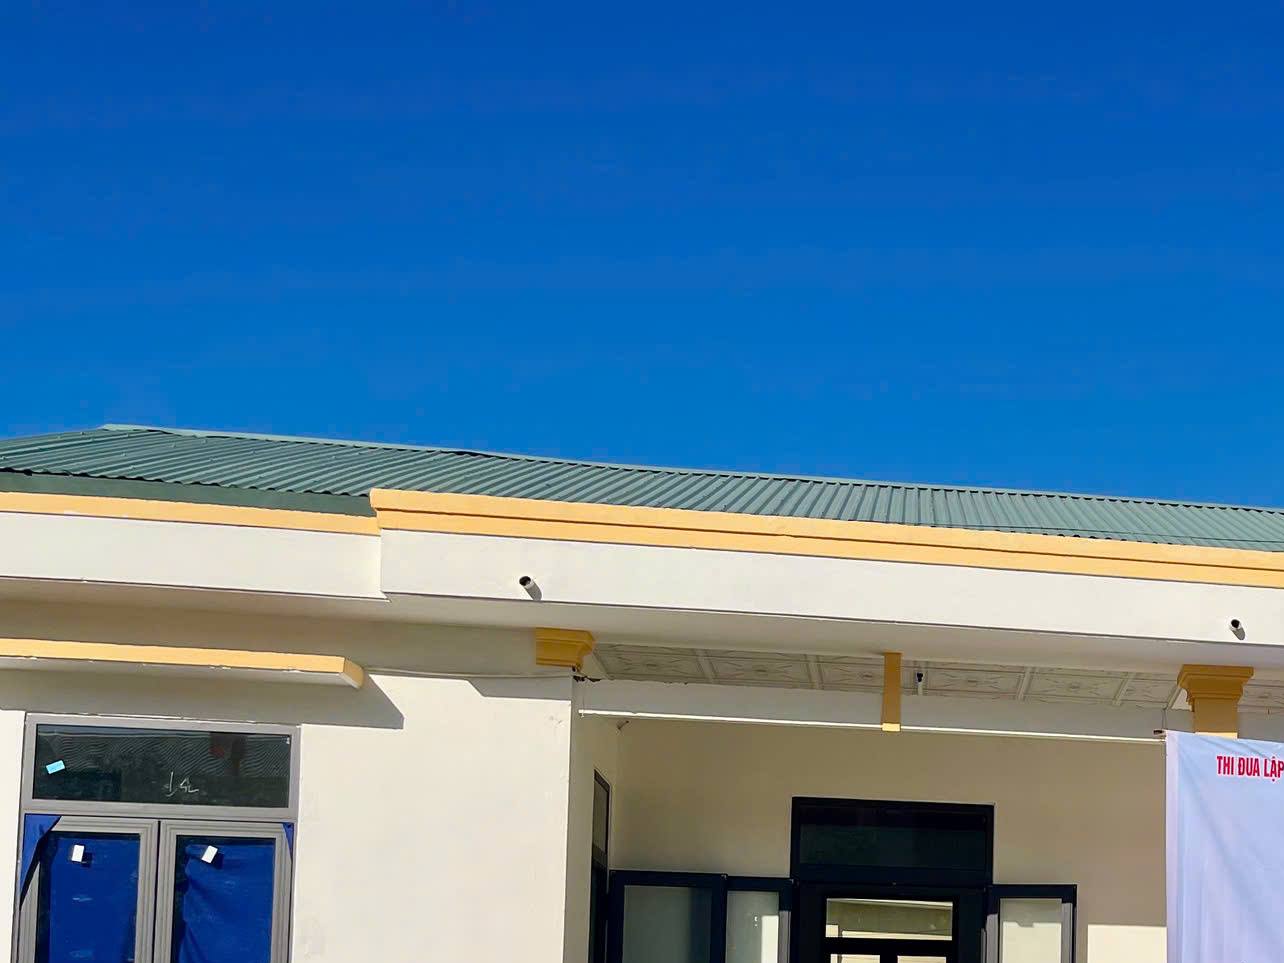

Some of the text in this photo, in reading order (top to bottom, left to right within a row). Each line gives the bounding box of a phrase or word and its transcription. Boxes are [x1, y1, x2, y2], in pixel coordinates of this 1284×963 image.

[1217, 756, 1234, 775] THI
[1238, 758, 1260, 776] ĐUA
[1264, 756, 1284, 781] LẬP
